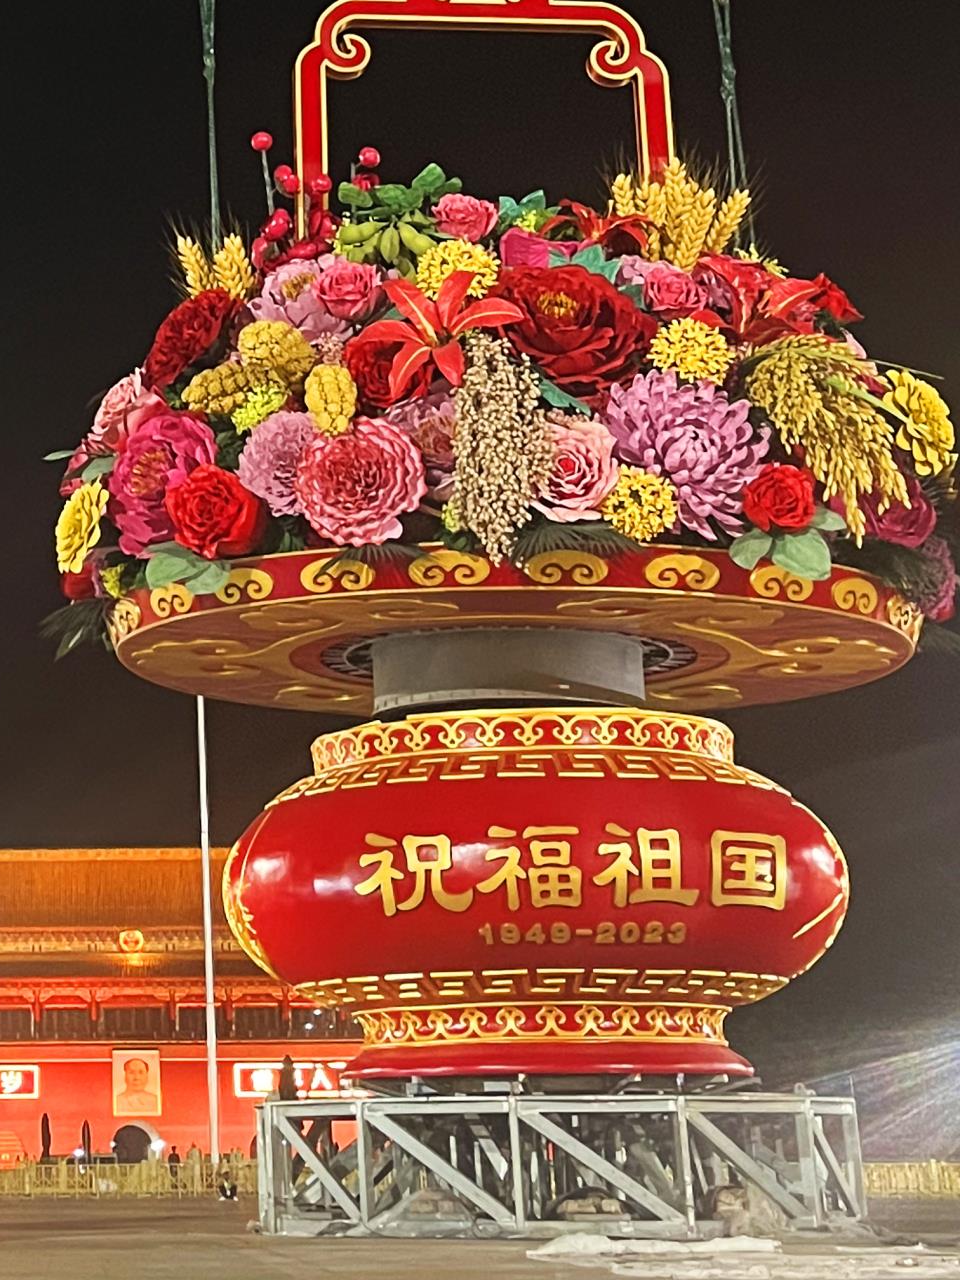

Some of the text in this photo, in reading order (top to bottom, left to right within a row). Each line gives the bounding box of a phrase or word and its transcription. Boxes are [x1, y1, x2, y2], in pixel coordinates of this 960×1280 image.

[355, 823, 787, 917] 祝福祖国
[478, 921, 687, 945] 1949-2023
